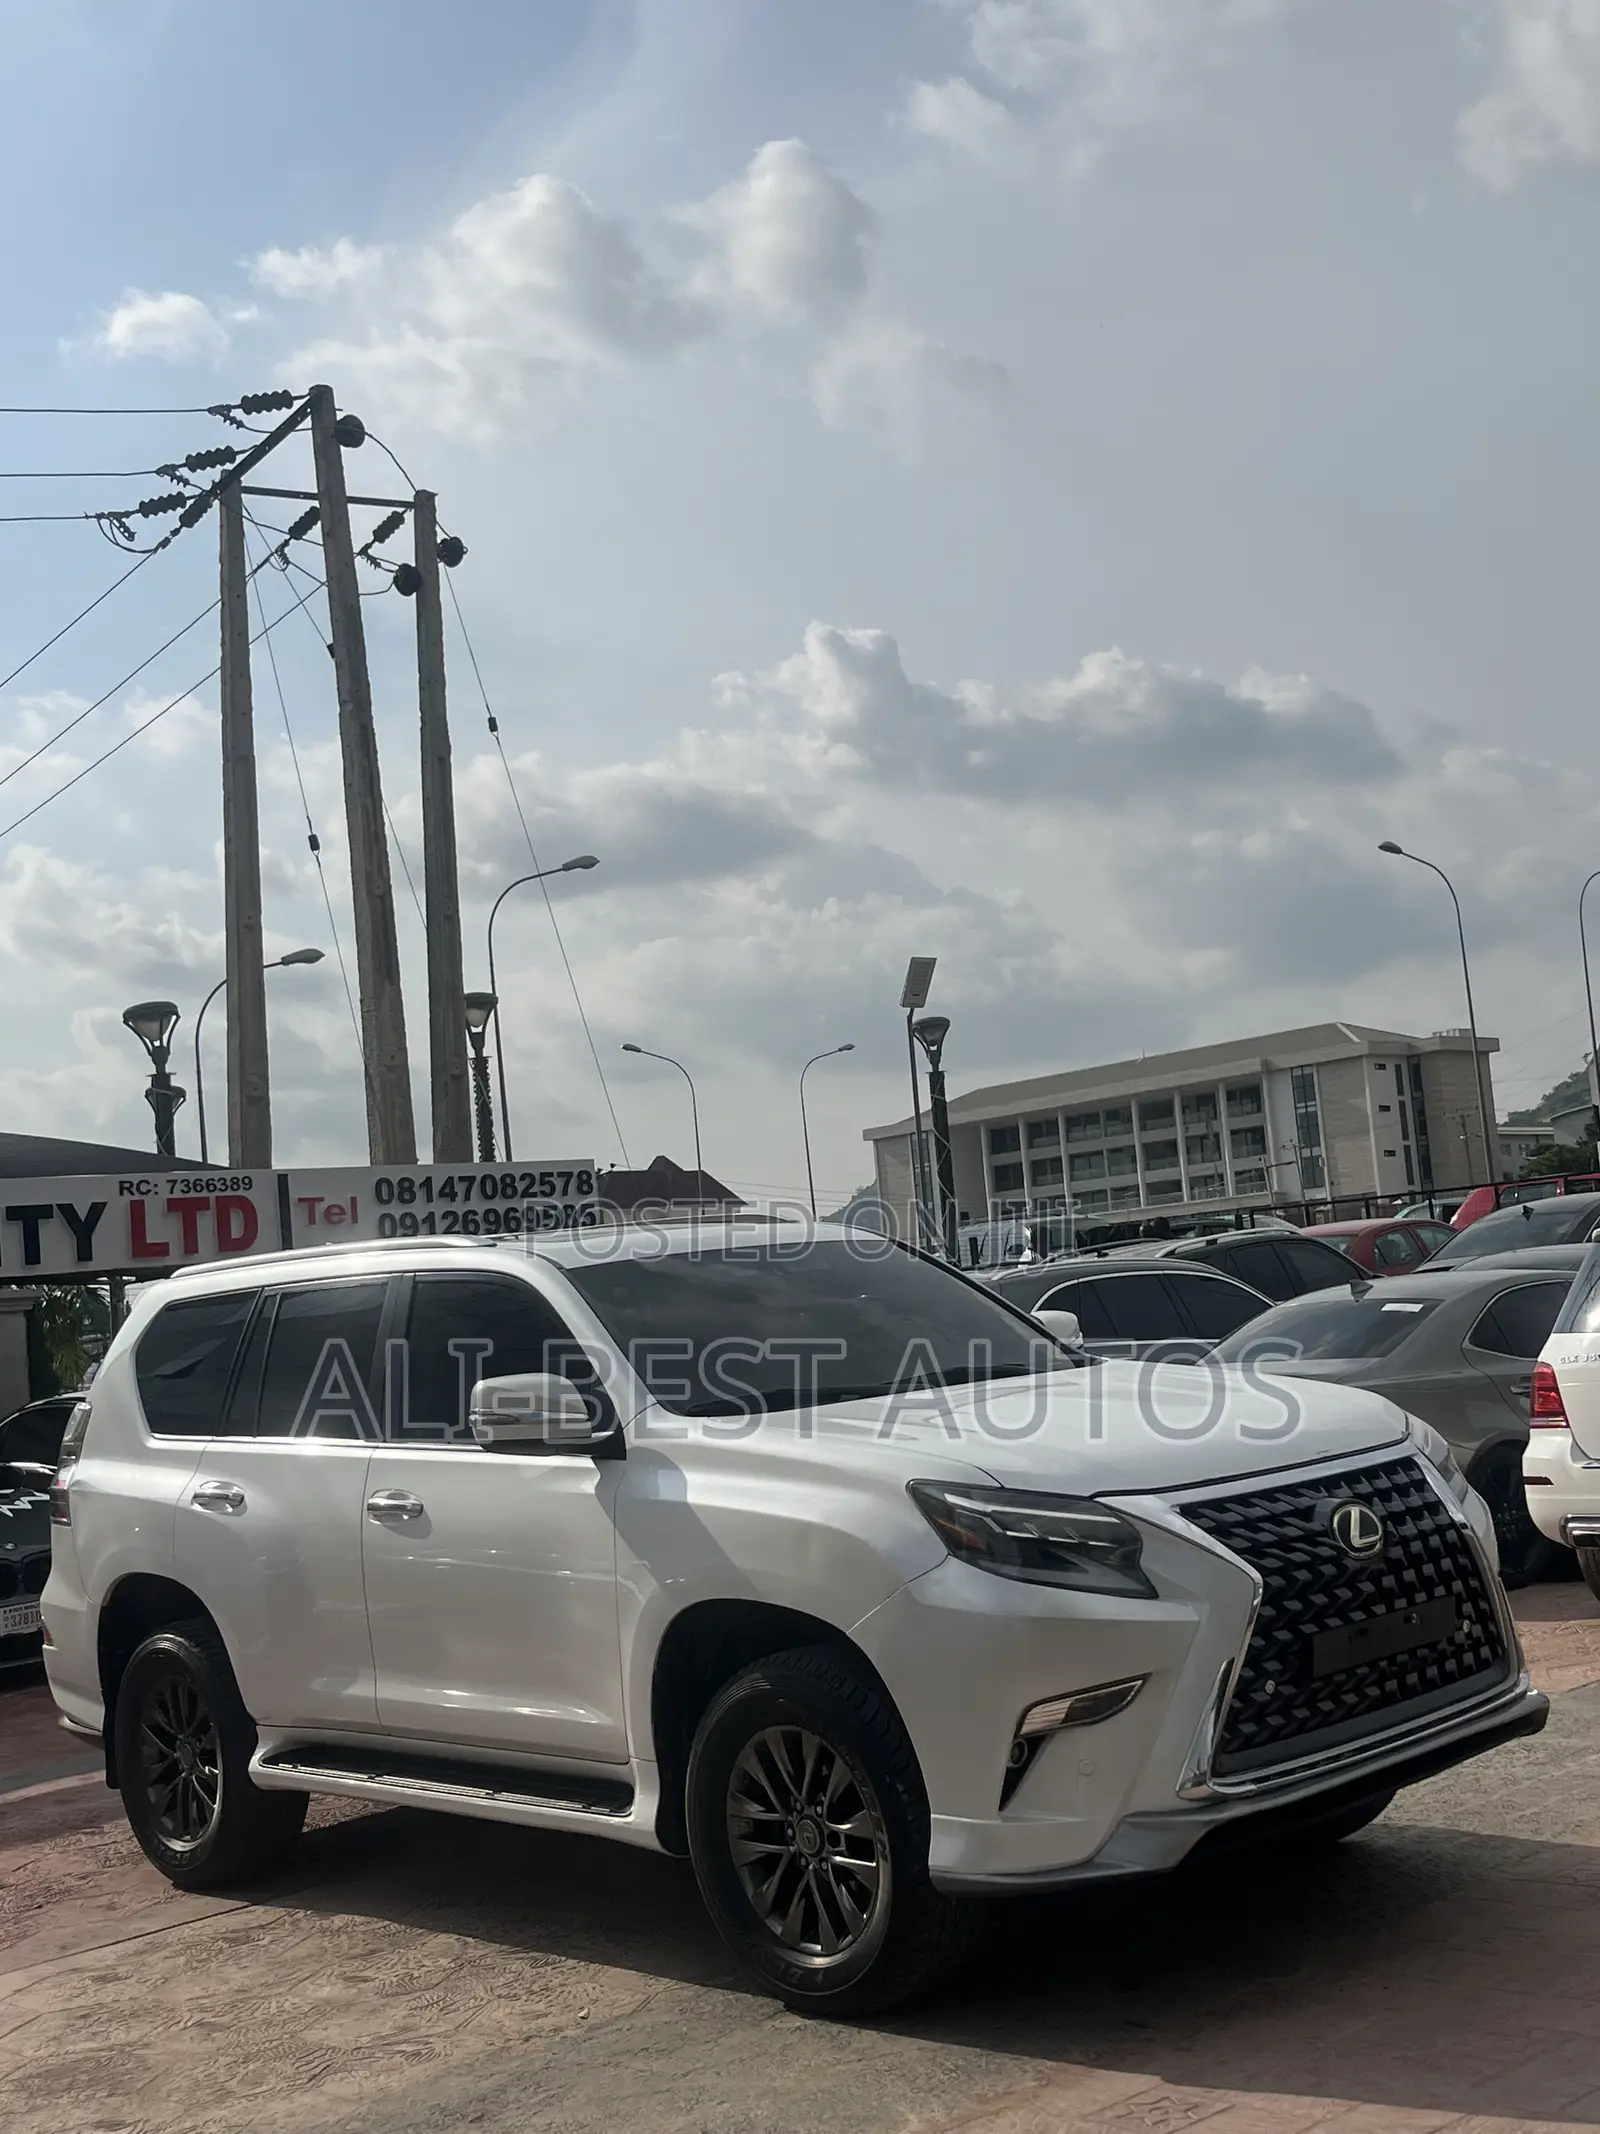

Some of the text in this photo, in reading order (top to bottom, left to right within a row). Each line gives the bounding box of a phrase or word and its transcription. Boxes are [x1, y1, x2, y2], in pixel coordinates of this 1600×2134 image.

[118, 1175, 253, 1196] RC: 7366389
[375, 1169, 594, 1205] 08147082578
[297, 1195, 358, 1226] Tel
[0, 1195, 259, 1267] TY LTD
